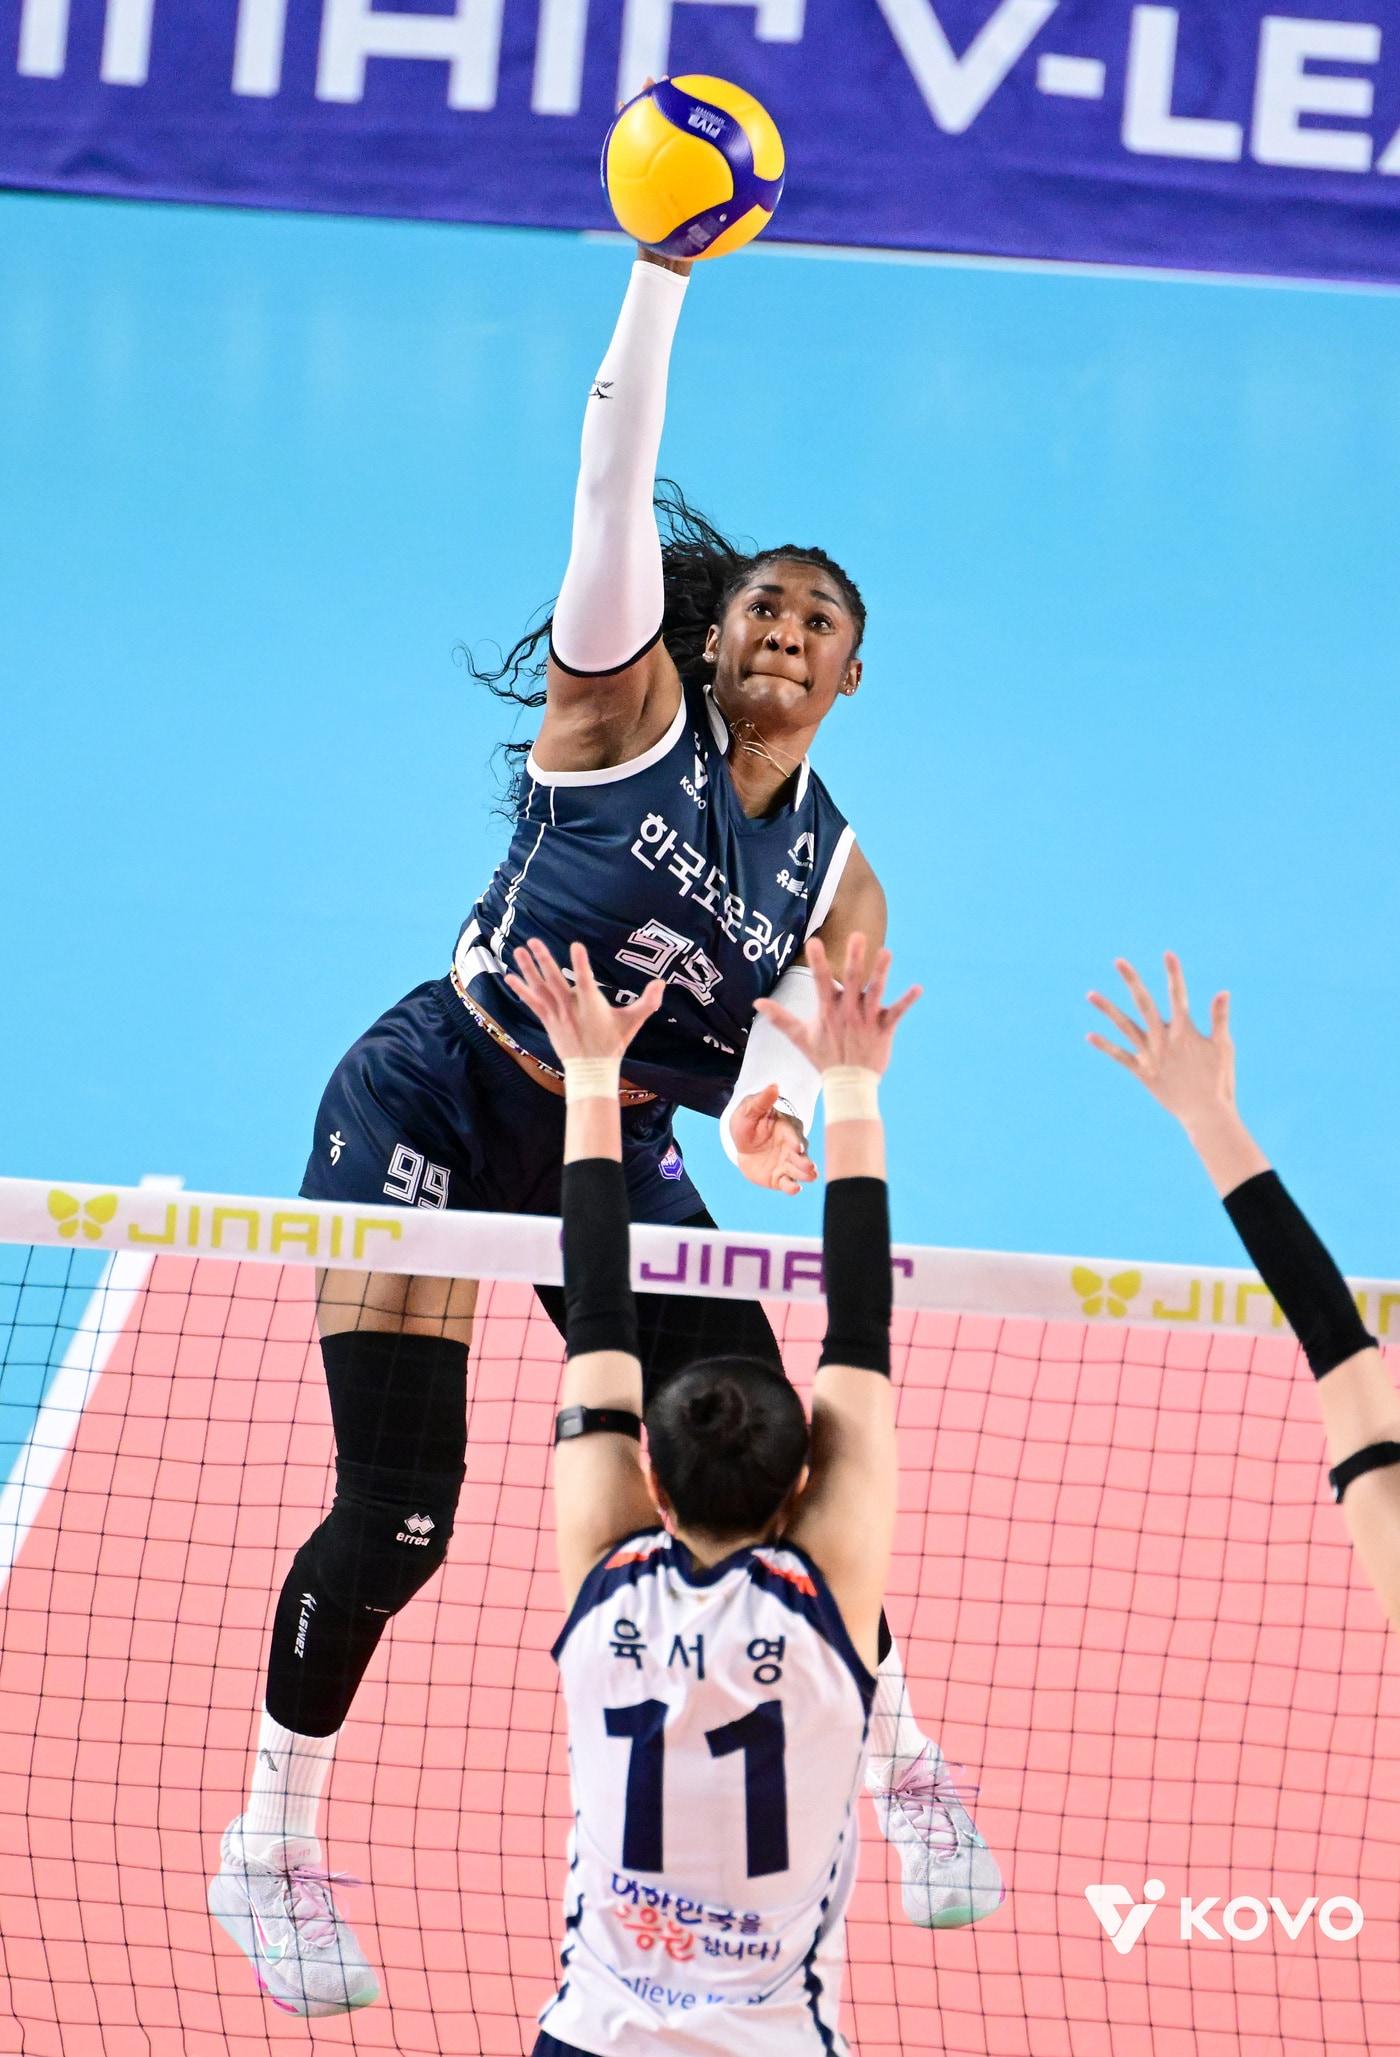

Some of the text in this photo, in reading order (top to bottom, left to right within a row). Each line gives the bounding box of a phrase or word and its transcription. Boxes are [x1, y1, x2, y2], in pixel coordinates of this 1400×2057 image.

[877, 0, 1400, 175] V-LE
[383, 1143, 451, 1211] 99
[128, 1204, 402, 1259] JINAIR
[640, 1242, 914, 1294] JINA
[1152, 1279, 1400, 1335] JINI
[603, 1698, 789, 1879] 11
[619, 1975, 696, 2010] lieve
